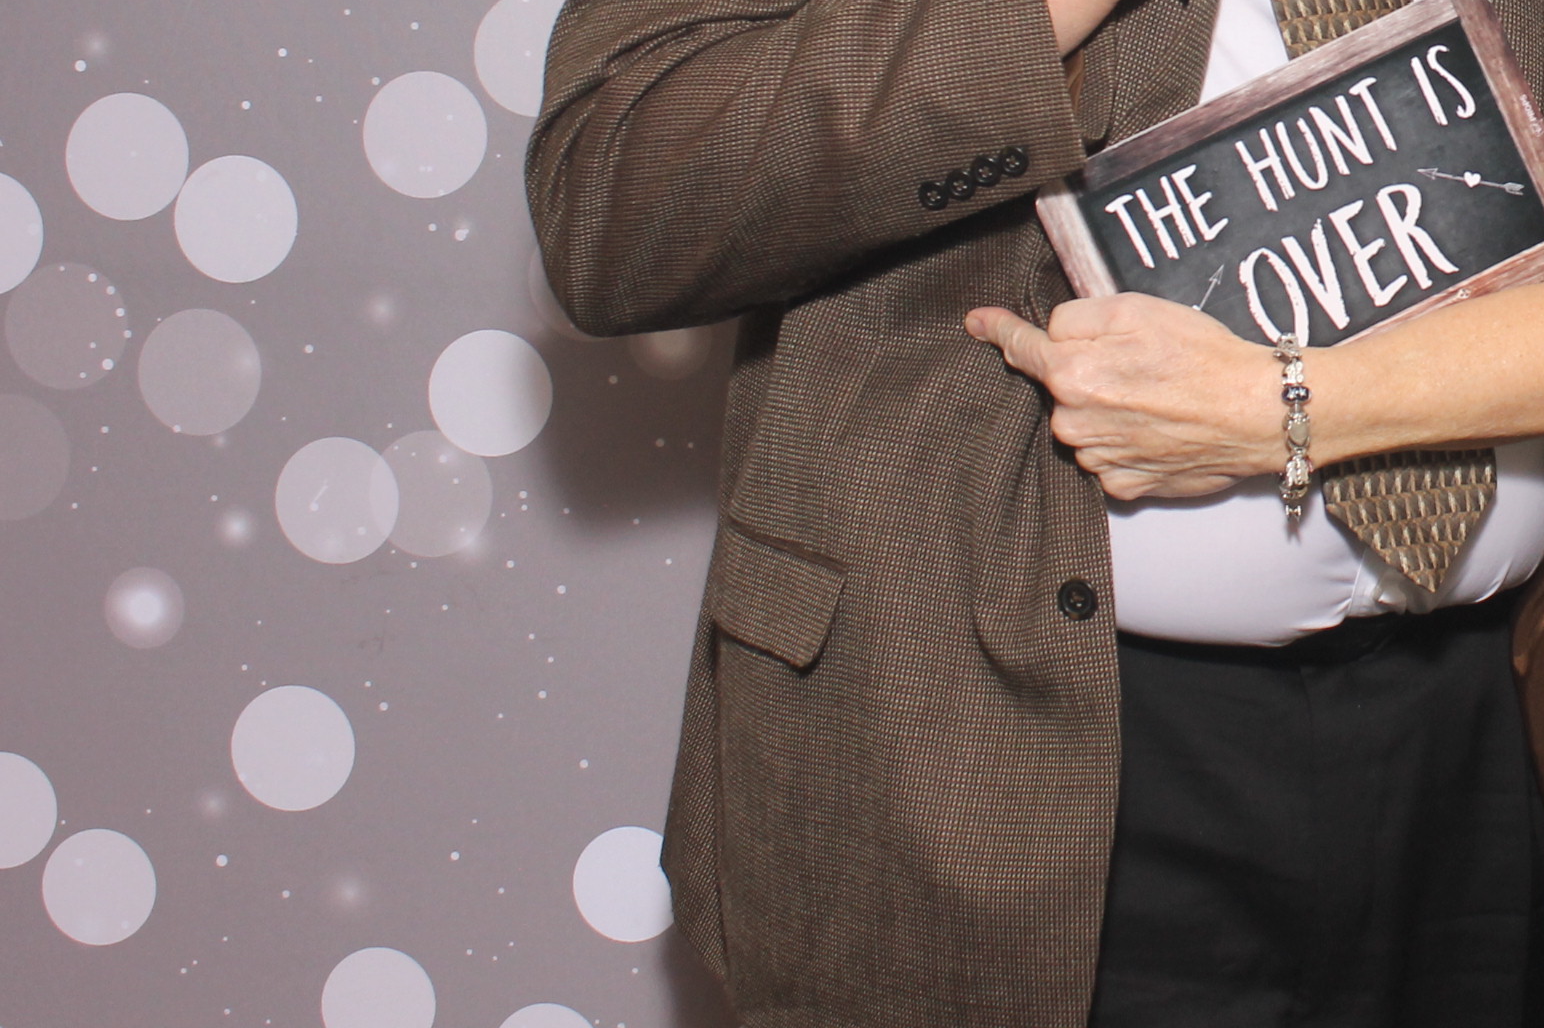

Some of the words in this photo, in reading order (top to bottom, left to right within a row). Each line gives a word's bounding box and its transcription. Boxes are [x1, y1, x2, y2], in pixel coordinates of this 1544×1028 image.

[1104, 164, 1229, 269] THE
[1235, 77, 1397, 212] HUNT
[1411, 44, 1476, 126] IS
[1238, 183, 1459, 347] OVER
